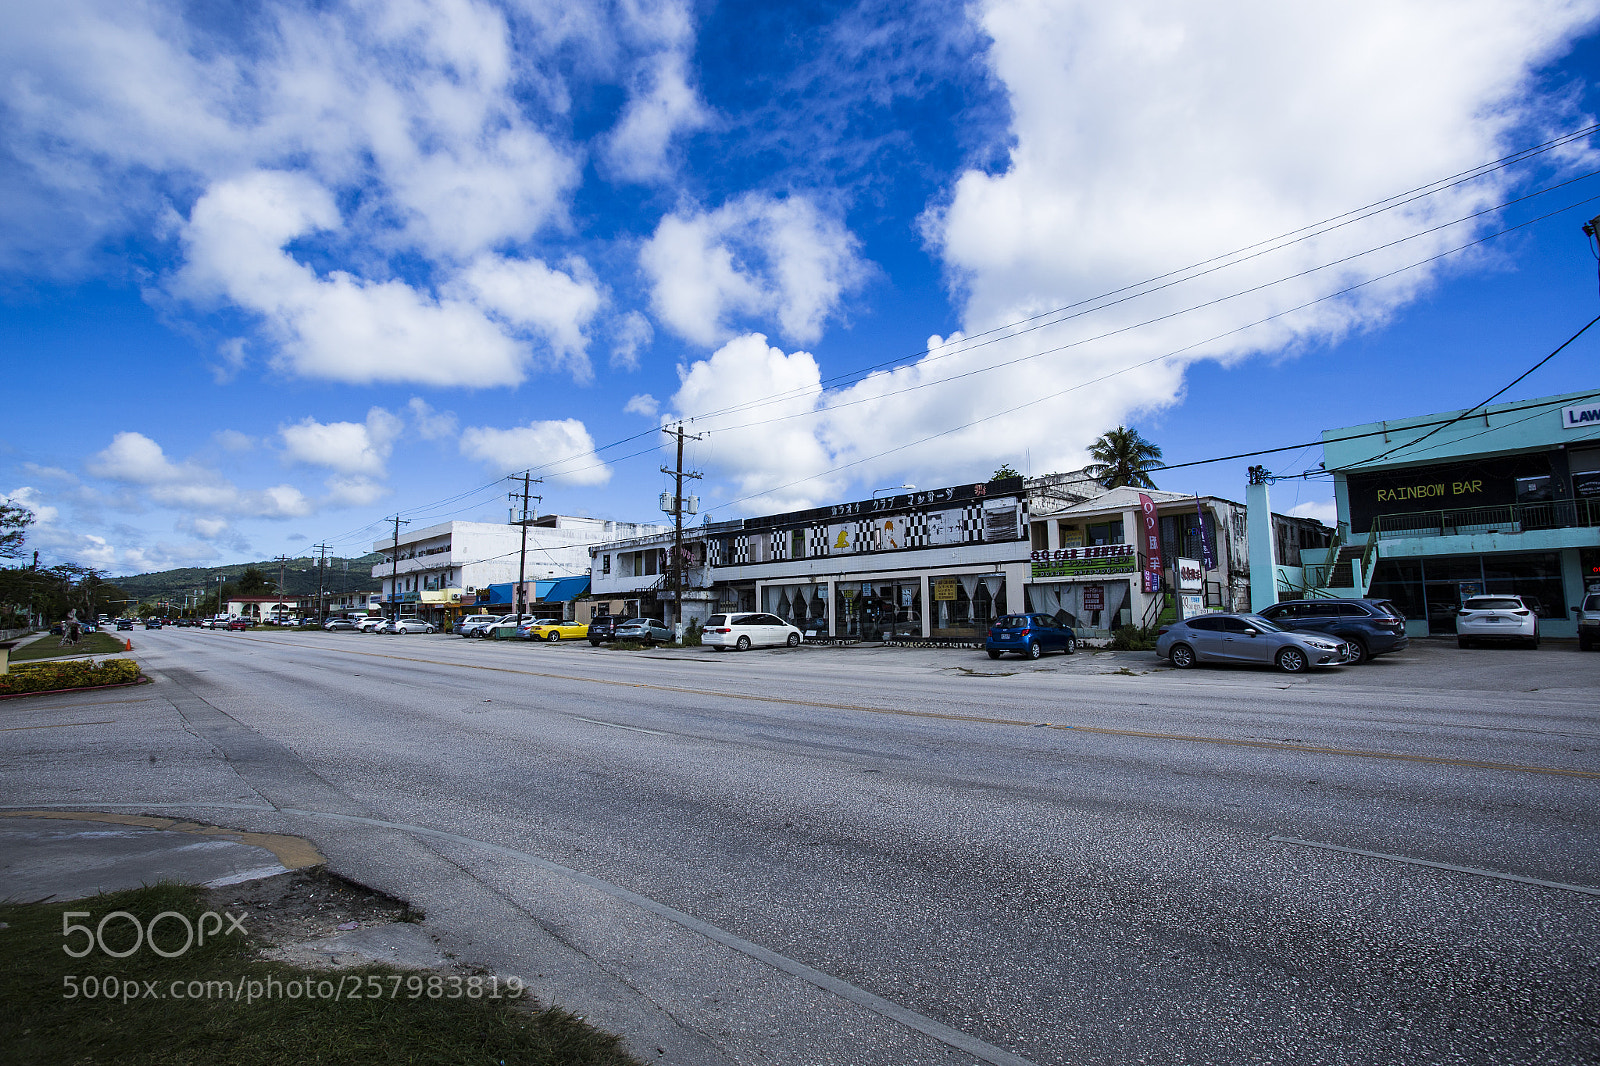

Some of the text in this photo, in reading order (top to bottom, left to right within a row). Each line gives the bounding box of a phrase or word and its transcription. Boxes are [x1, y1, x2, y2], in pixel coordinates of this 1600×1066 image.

[1377, 480, 1483, 502] RAINBOW BAR
[1054, 549, 1078, 560] CAR
[1084, 545, 1134, 558] RENTAL
